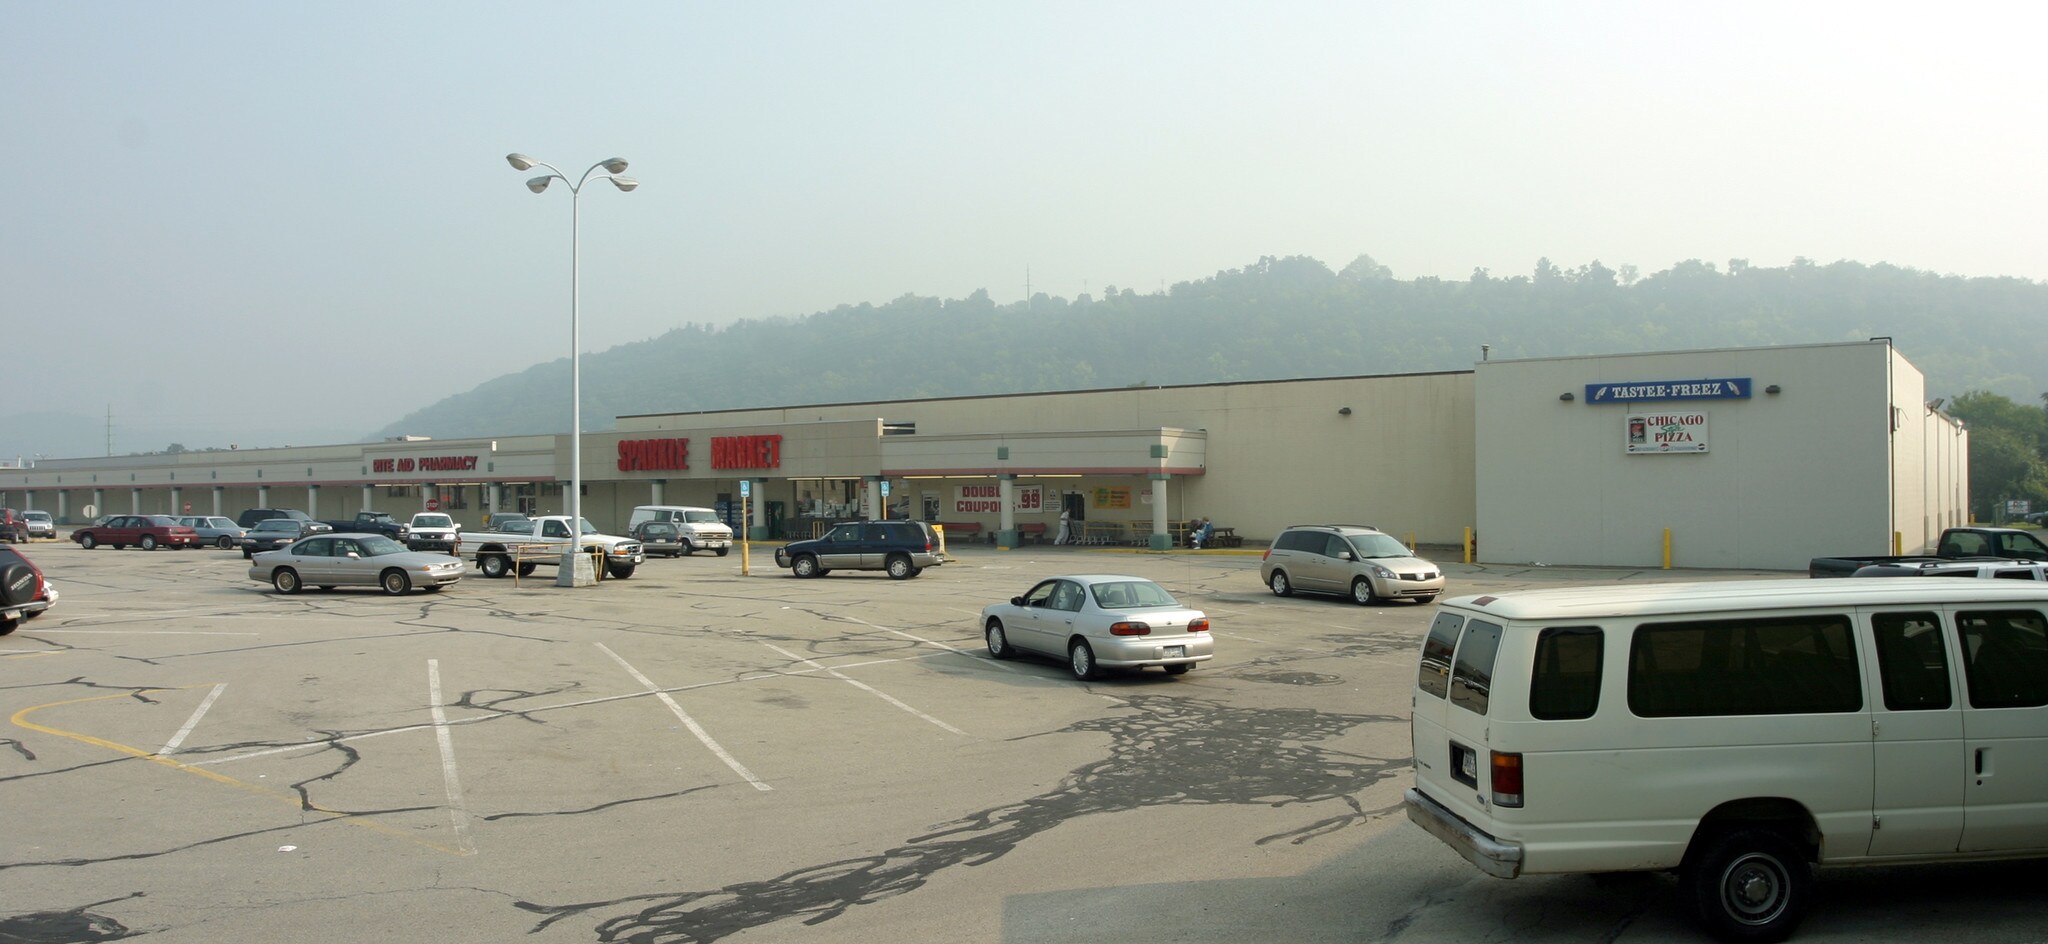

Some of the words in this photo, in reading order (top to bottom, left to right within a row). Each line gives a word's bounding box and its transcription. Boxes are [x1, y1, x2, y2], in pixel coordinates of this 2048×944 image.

[1647, 415, 1704, 426] CHICAGO
[1655, 432, 1693, 442] PIZZA
[617, 438, 690, 472] SPARKLE
[711, 435, 783, 470] MARKET
[373, 459, 394, 472] RITE
[397, 458, 415, 472] AID
[419, 456, 478, 471] PHARMACY
[962, 486, 1002, 497] DOUBL
[11, 573, 33, 591] HONDA
